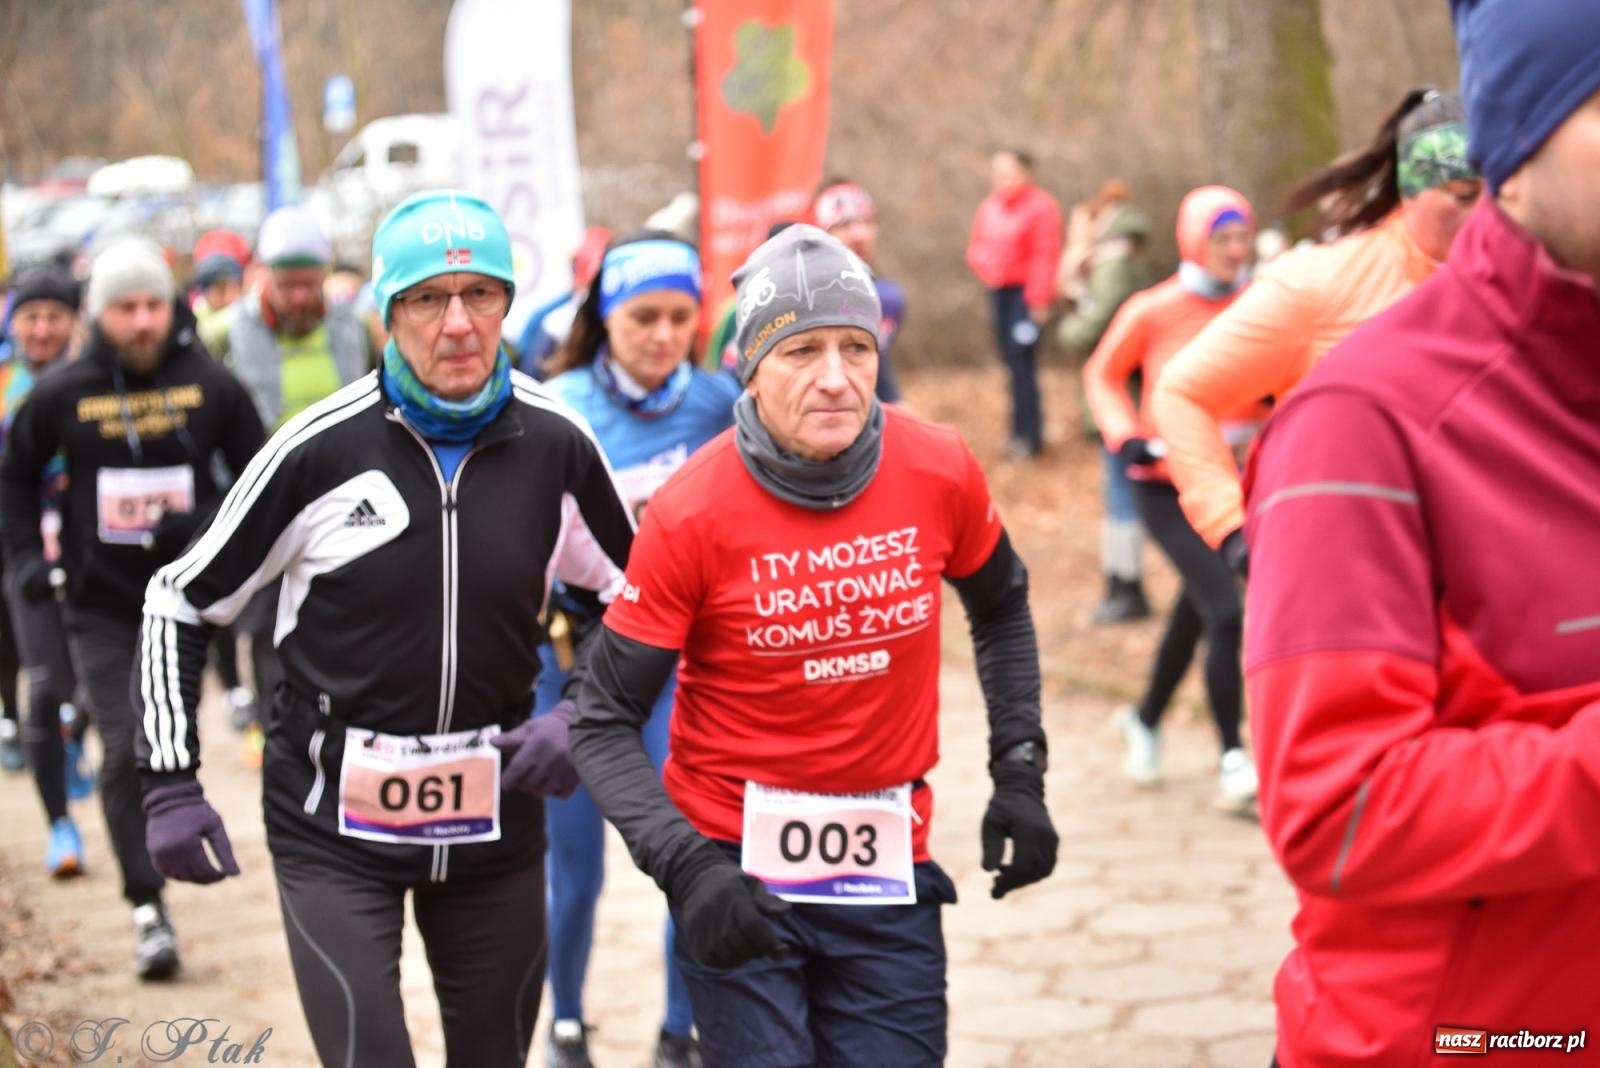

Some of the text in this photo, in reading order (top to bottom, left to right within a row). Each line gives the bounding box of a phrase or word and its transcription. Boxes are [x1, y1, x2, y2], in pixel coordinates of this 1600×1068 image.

[421, 206, 486, 248] DNB
[750, 526, 920, 583] I TY MOŻESZ
[754, 555, 923, 617] URATOWAĆ
[746, 605, 853, 648] KOMUŚ
[804, 653, 870, 681] DKMS
[379, 773, 463, 813] 061
[780, 820, 877, 867] 003
